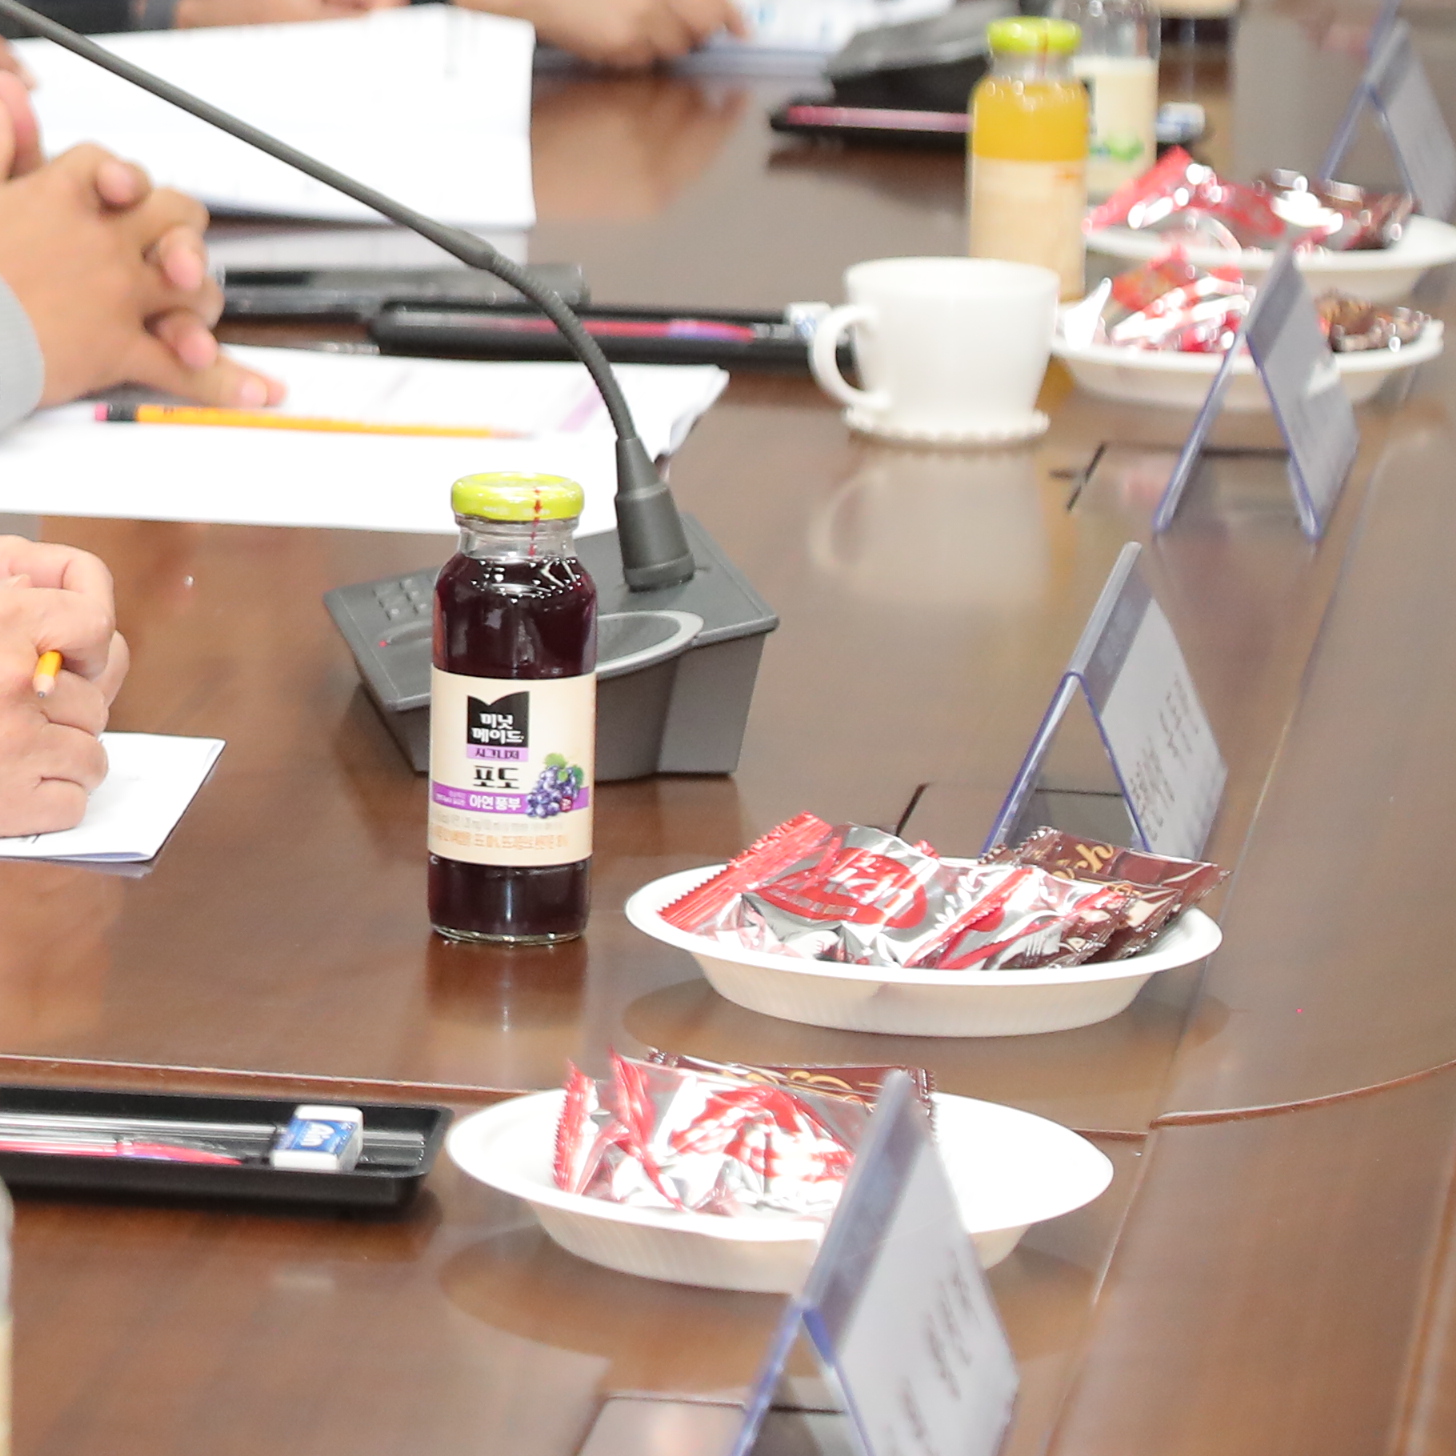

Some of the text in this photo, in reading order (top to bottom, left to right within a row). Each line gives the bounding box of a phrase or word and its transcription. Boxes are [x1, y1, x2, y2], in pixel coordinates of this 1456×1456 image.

[479, 713, 513, 729] 미닛
[472, 727, 523, 744] 메이드
[473, 765, 520, 789] 포도
